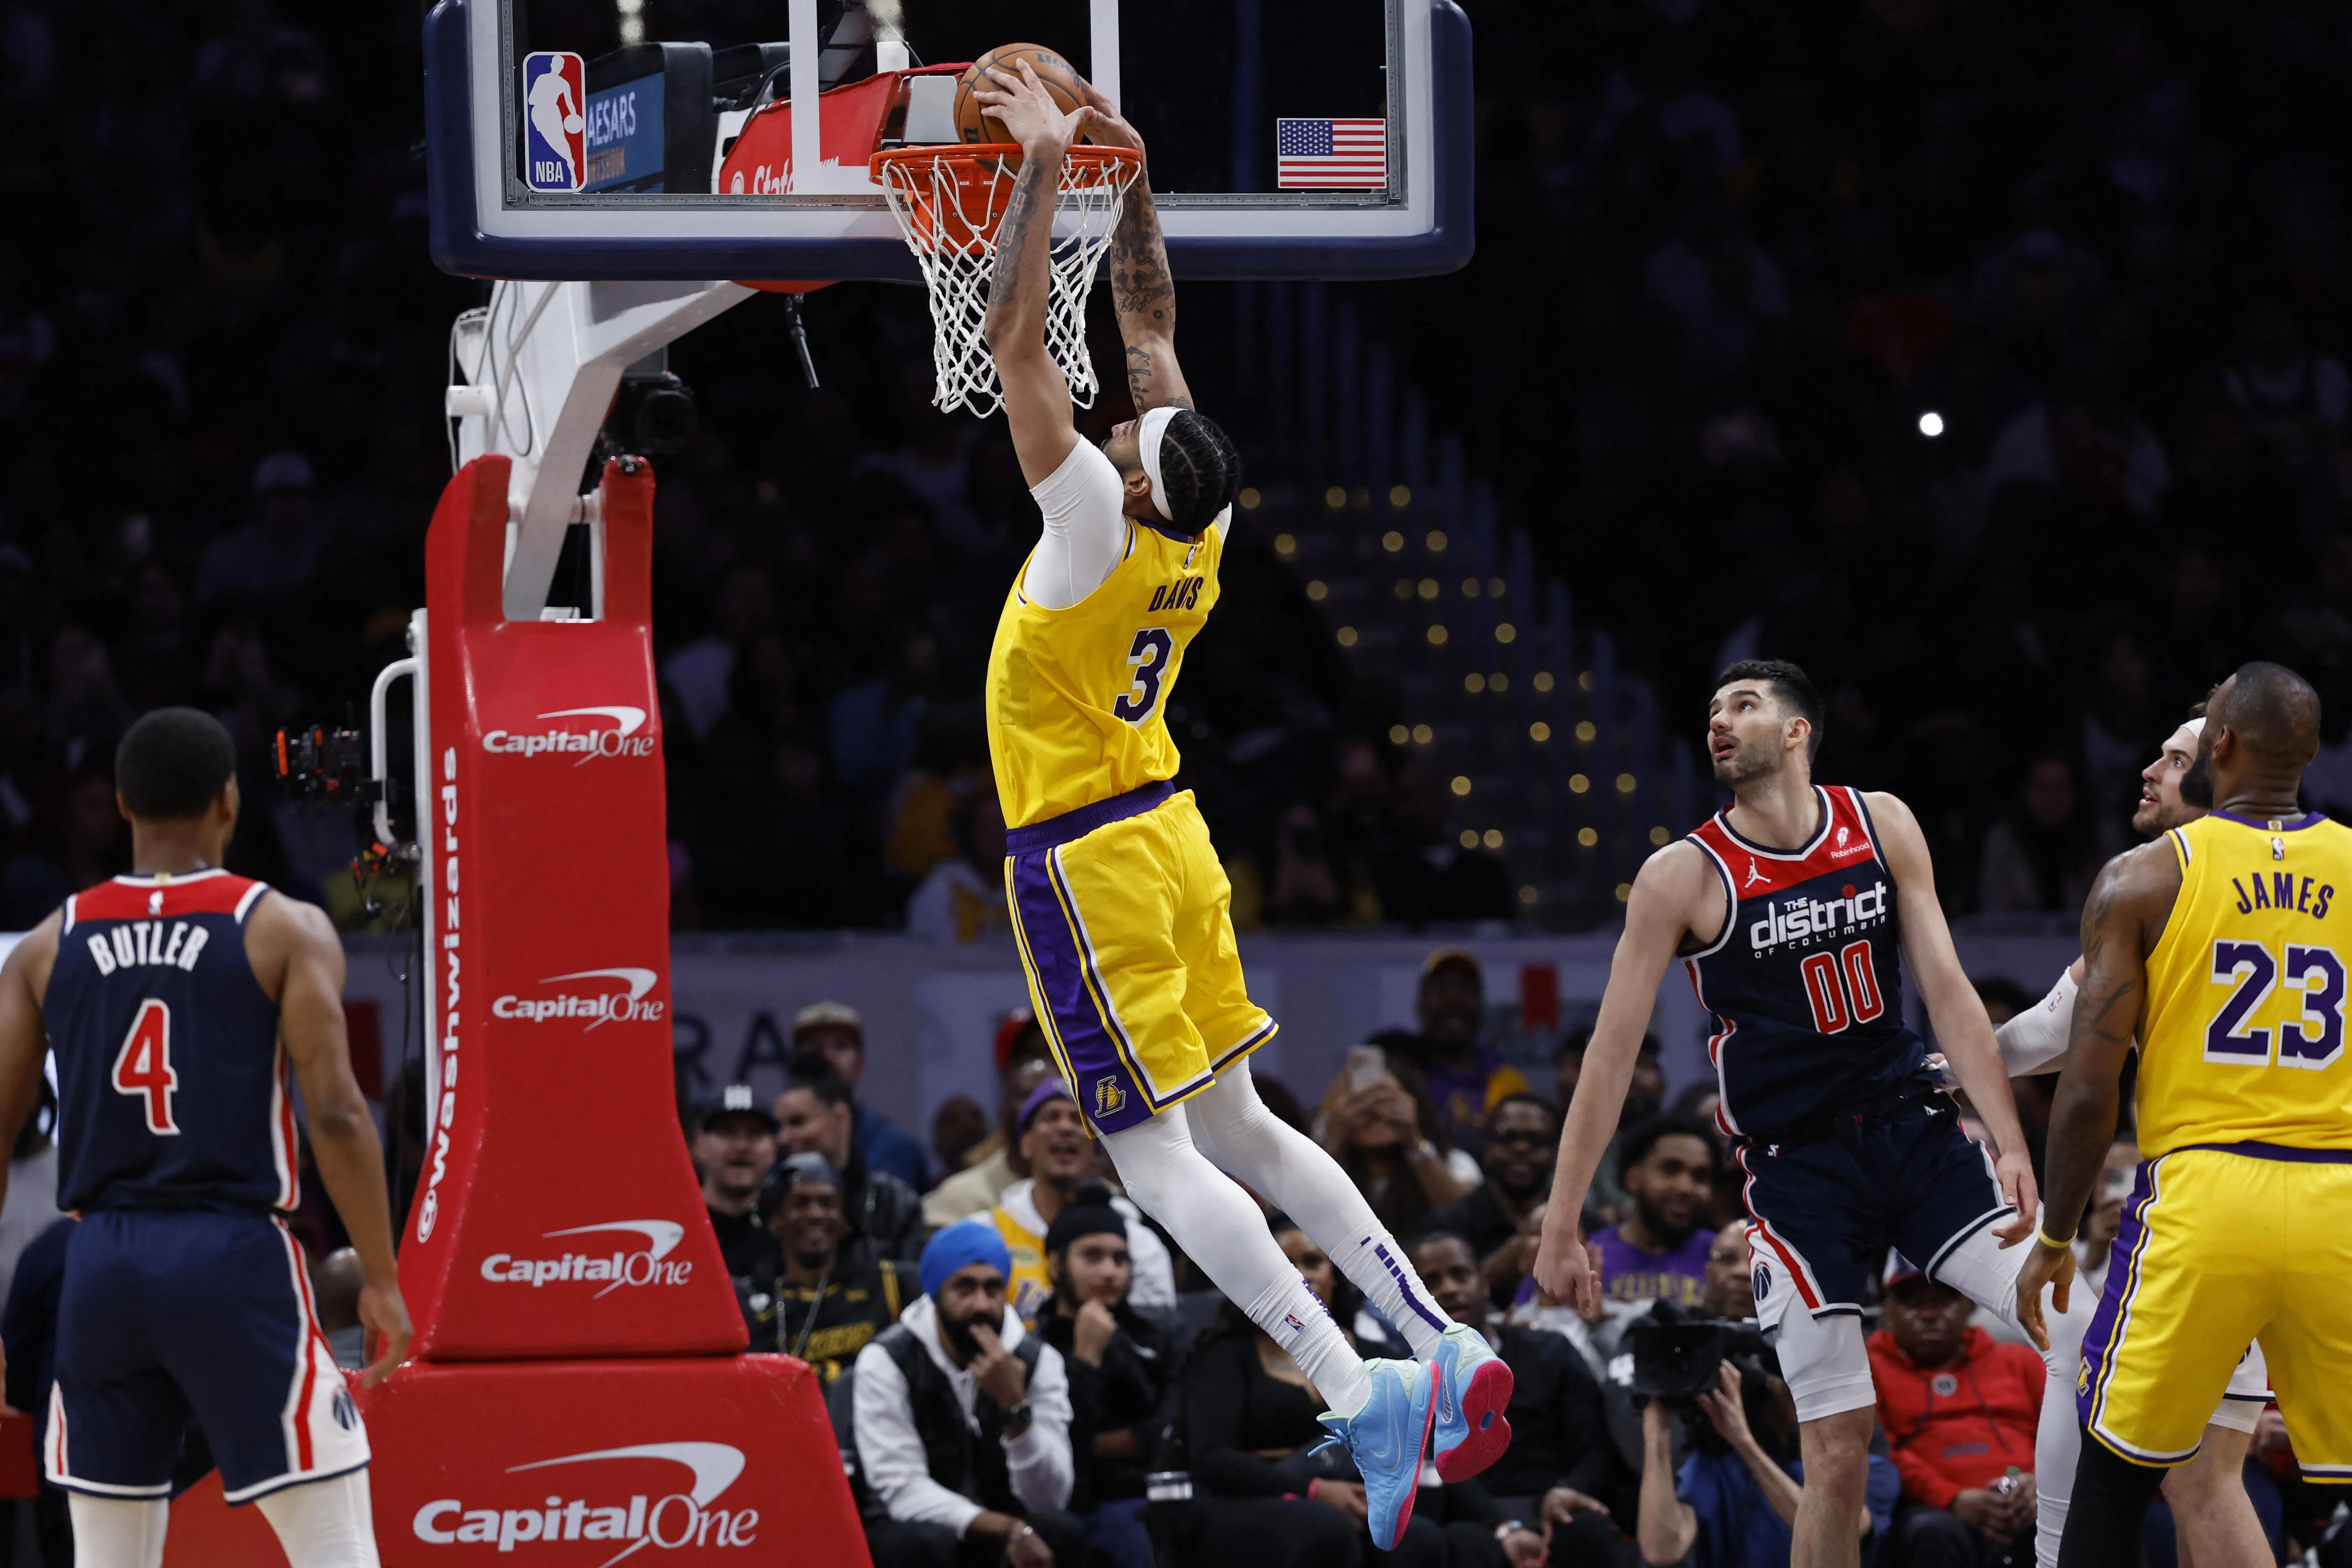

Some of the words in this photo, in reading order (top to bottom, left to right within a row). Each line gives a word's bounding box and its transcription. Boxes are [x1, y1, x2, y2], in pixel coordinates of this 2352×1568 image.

[587, 91, 637, 147] AESARS
[536, 161, 564, 183] NBA
[1112, 626, 1175, 729] 3
[1830, 842, 1870, 859] Robinhood
[1750, 881, 1886, 950] district
[1784, 897, 1808, 912] THE
[2232, 872, 2334, 919] JAMES
[87, 920, 210, 977] BUTLER
[1754, 947, 1775, 959] OF
[1788, 915, 1886, 950] COLUMBIA
[1800, 939, 1884, 1034] 00
[2203, 938, 2348, 1071] 23
[111, 997, 181, 1136] 4
